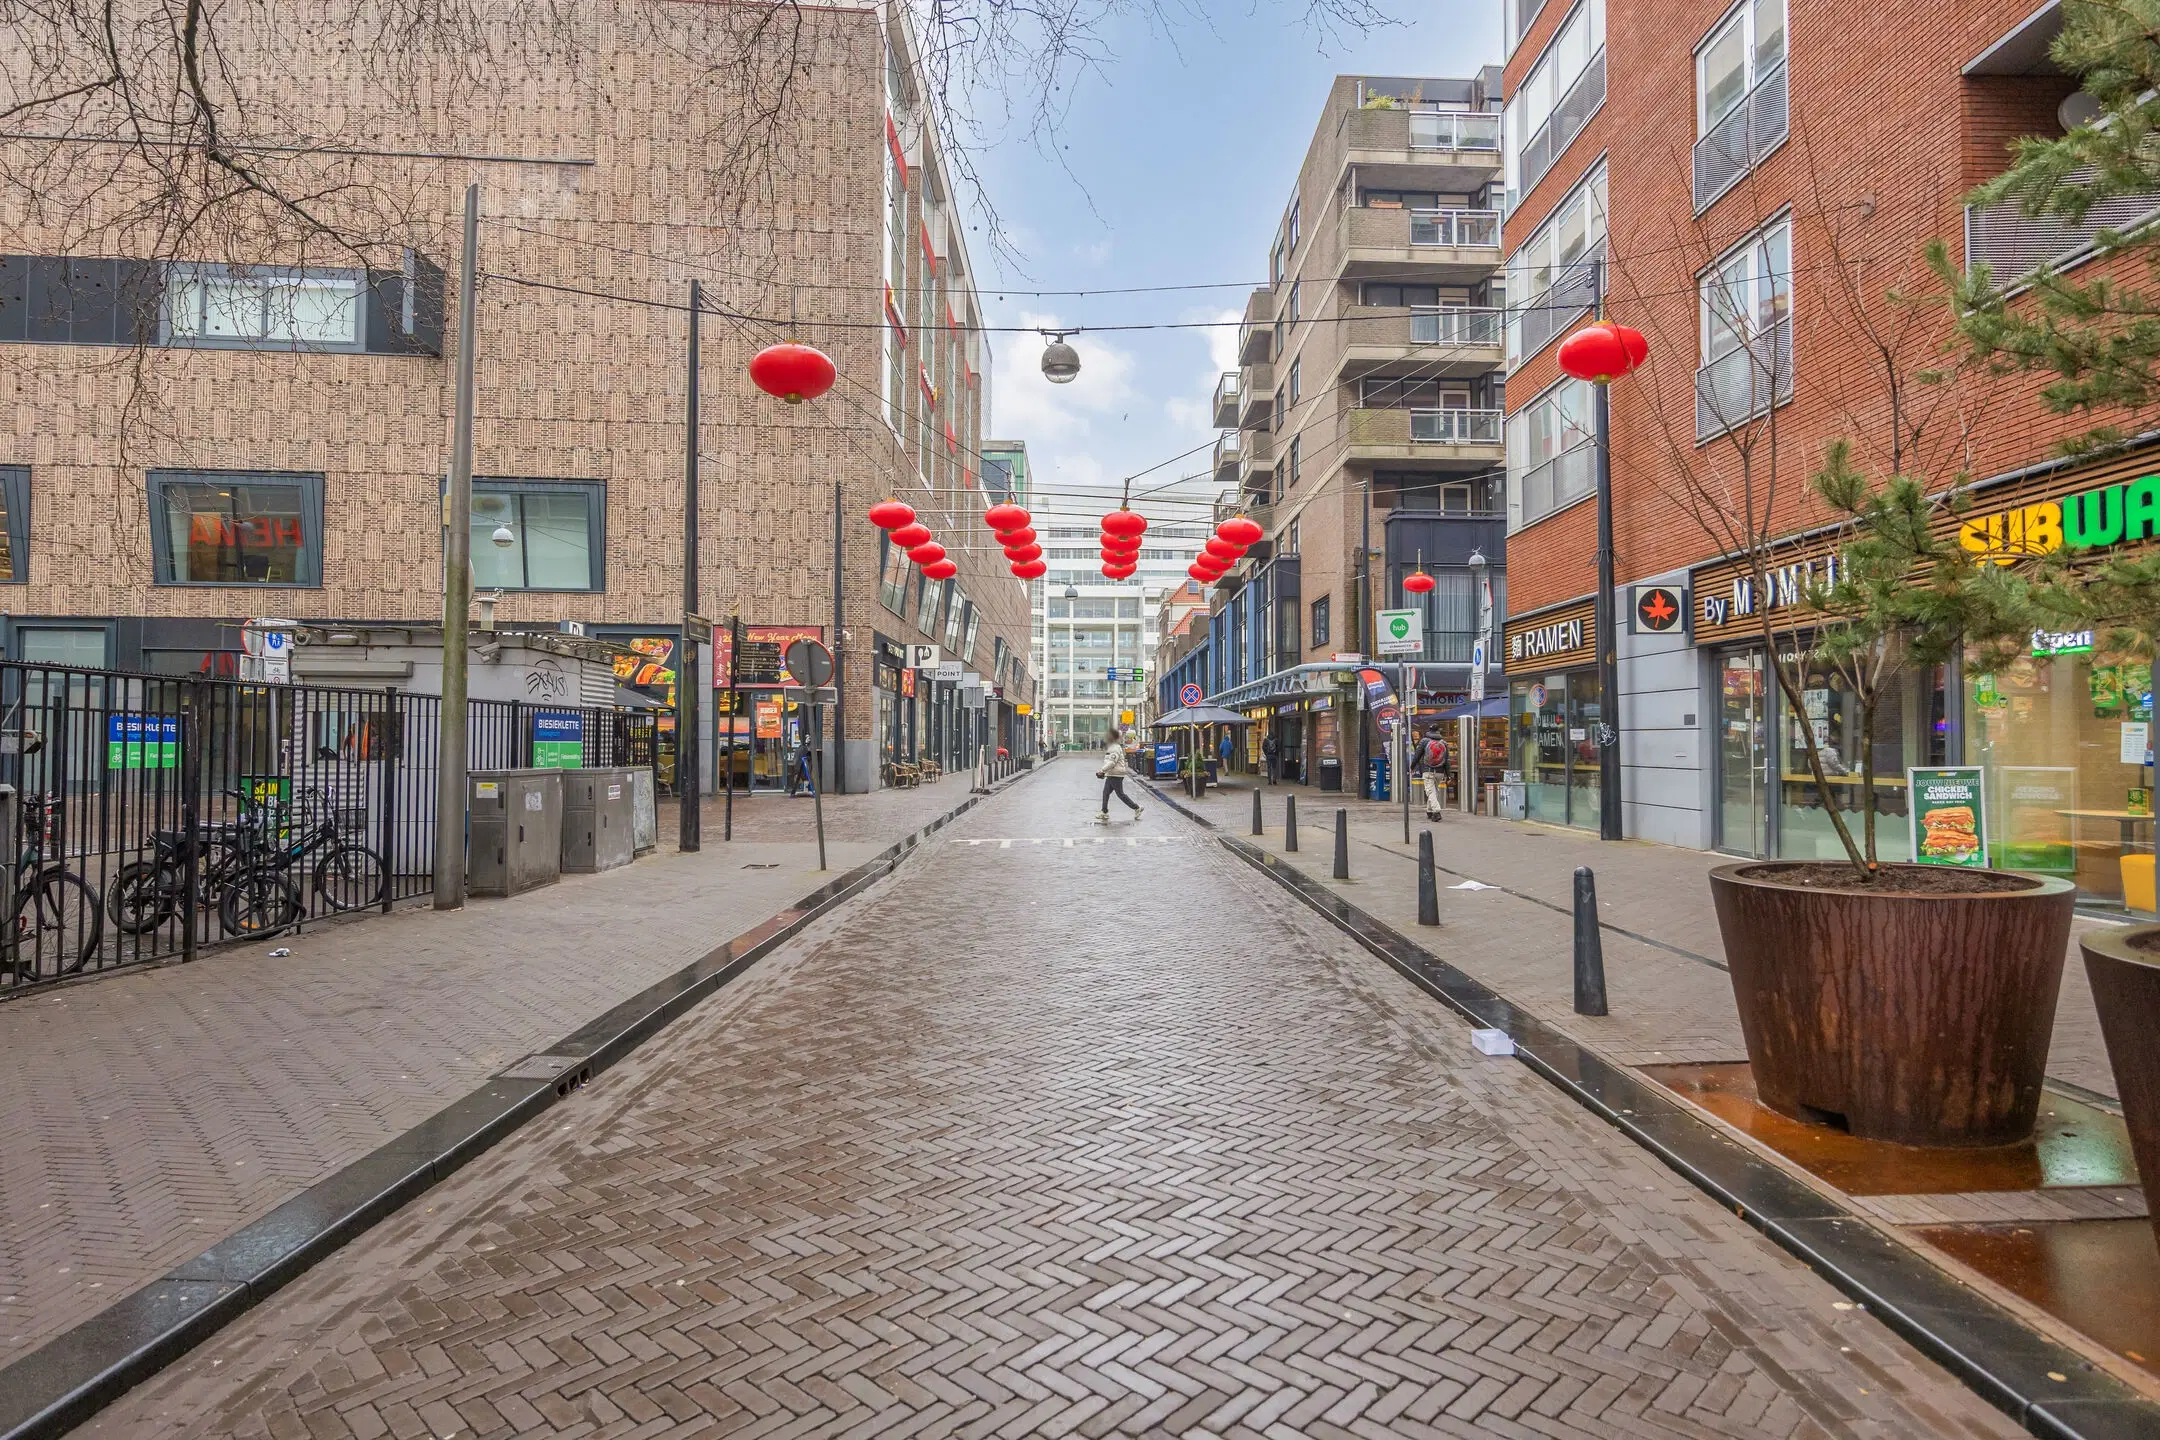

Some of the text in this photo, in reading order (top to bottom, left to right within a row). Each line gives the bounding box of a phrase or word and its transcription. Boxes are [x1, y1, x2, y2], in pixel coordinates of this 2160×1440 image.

[1960, 476, 2160, 568] SUBWA
[1704, 595, 1726, 625] By
[1392, 623, 1406, 631] hub
[747, 633, 765, 642] New
[767, 632, 790, 643] Year
[1525, 619, 1581, 657] RAMEN
[2032, 630, 2093, 654] Open
[1419, 695, 1465, 705] SIMONIS
[538, 719, 580, 730] BIESIEKLETTE
[1916, 778, 1980, 787] JOUW NIEUWE
[1923, 792, 1973, 800] SANDWICH
